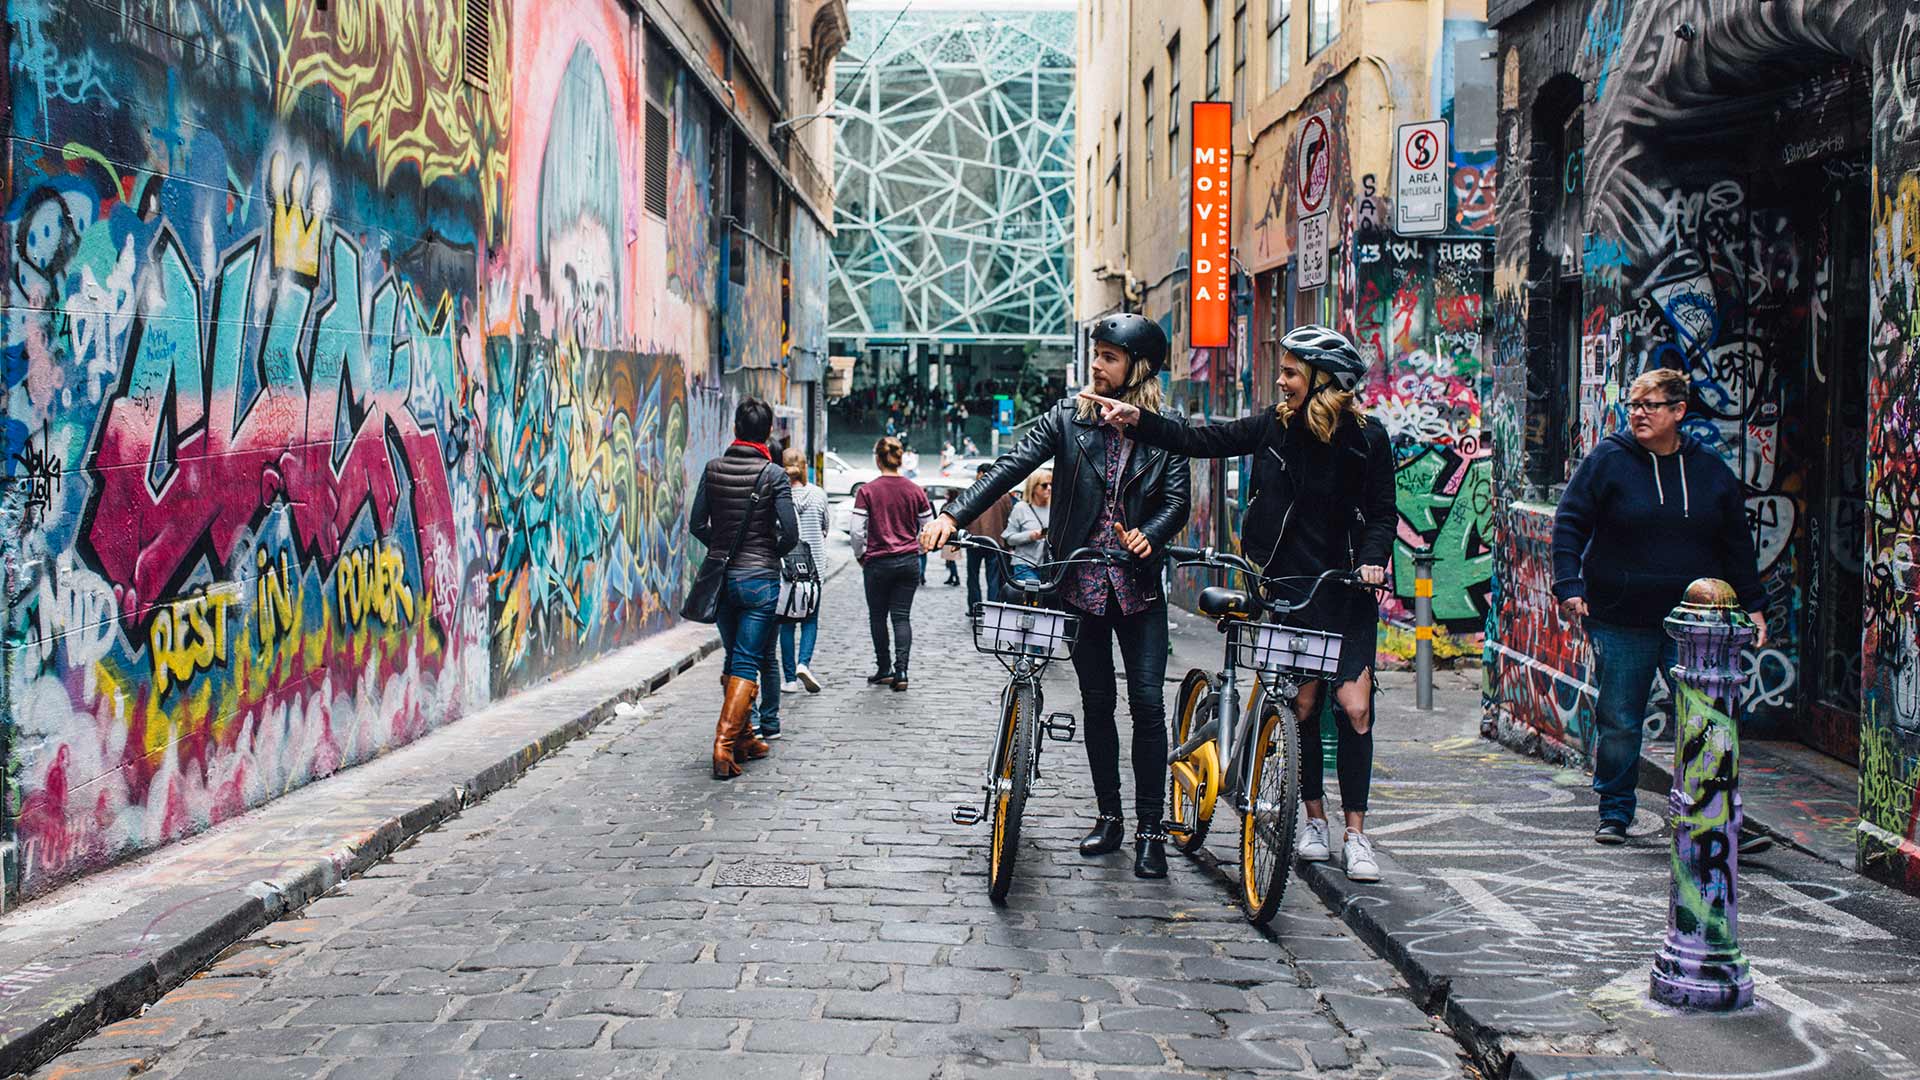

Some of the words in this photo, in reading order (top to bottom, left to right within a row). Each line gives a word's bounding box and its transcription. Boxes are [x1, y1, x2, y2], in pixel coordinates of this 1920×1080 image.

[1219, 180, 1228, 197] DE
[1401, 186, 1431, 197] RUTLEDGE
[1434, 185, 1442, 194] LA
[1408, 172, 1439, 185] AREA
[1195, 147, 1215, 301] MOVIDA
[1218, 204, 1227, 245] TAPAS
[150, 578, 240, 694] REST
[336, 540, 415, 626] POWER
